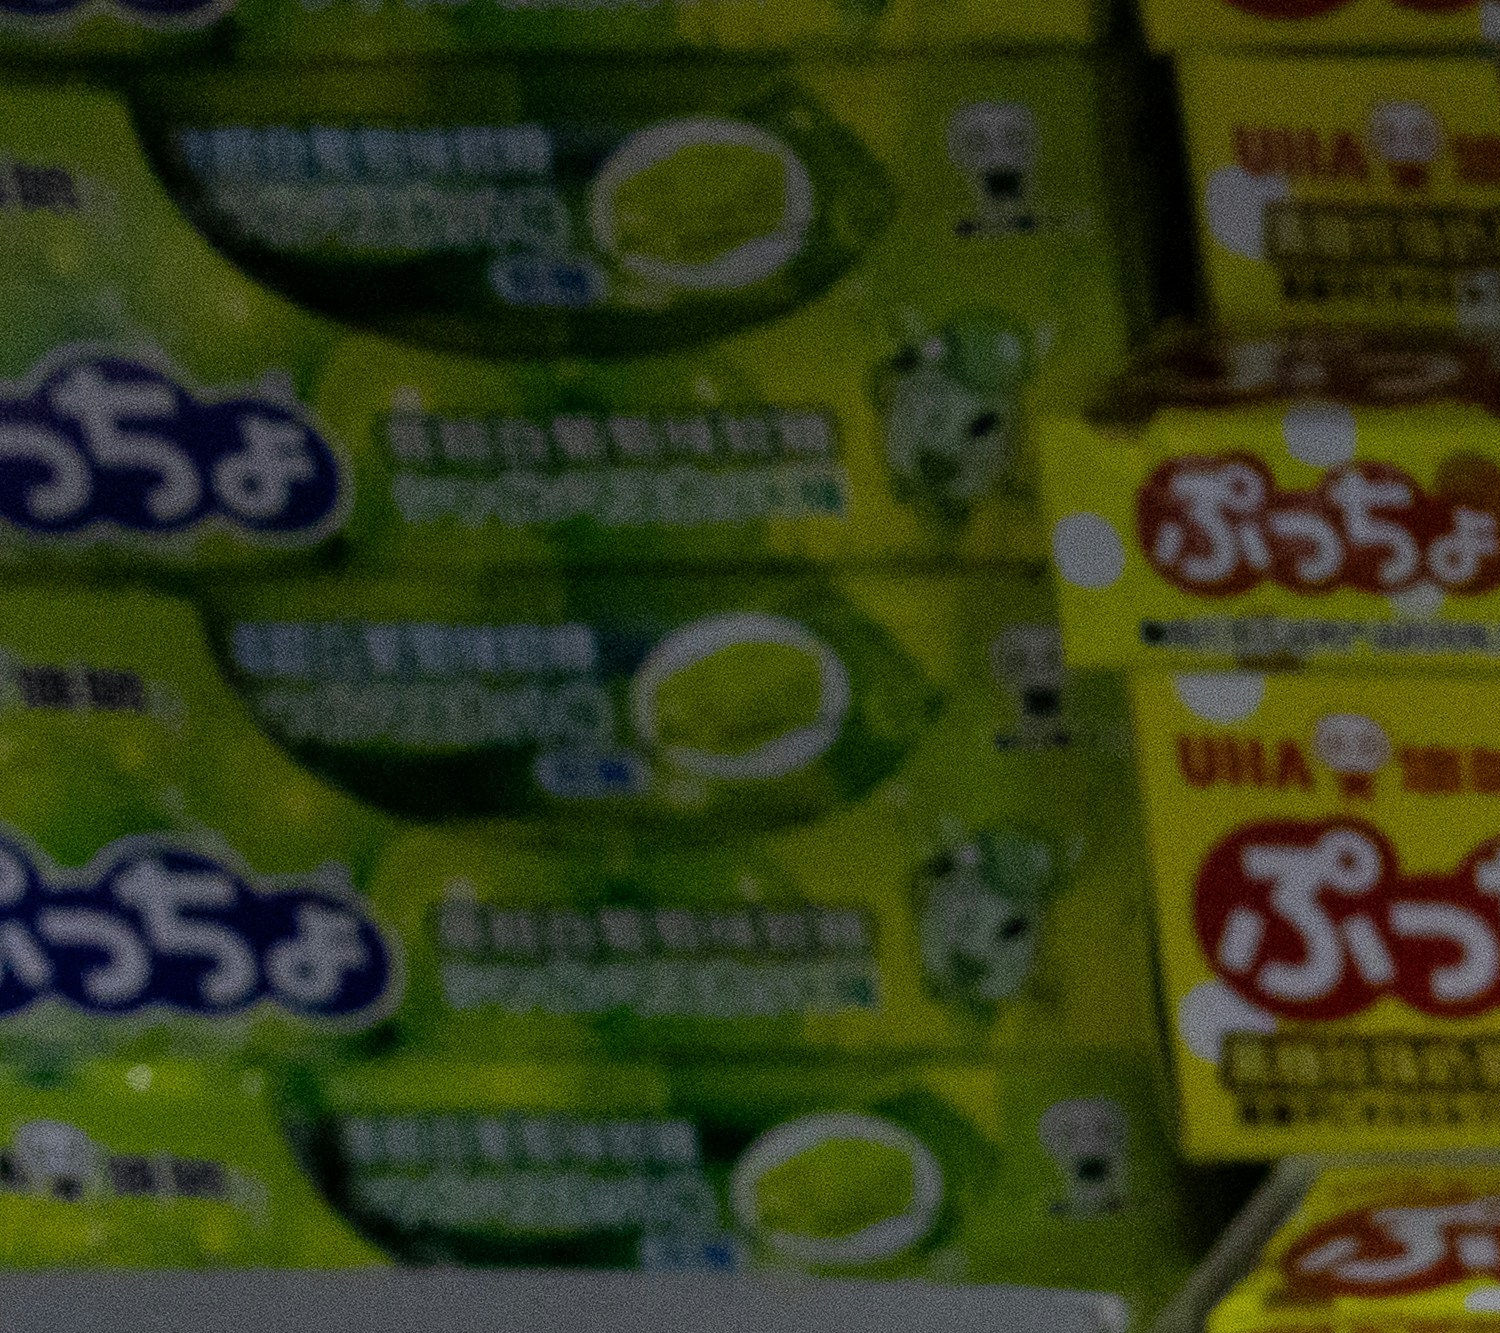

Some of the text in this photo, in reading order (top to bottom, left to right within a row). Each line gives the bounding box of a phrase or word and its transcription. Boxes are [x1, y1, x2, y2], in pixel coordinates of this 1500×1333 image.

[1156, 464, 1500, 585] ぷっちょ
[1177, 737, 1311, 790] UHA
